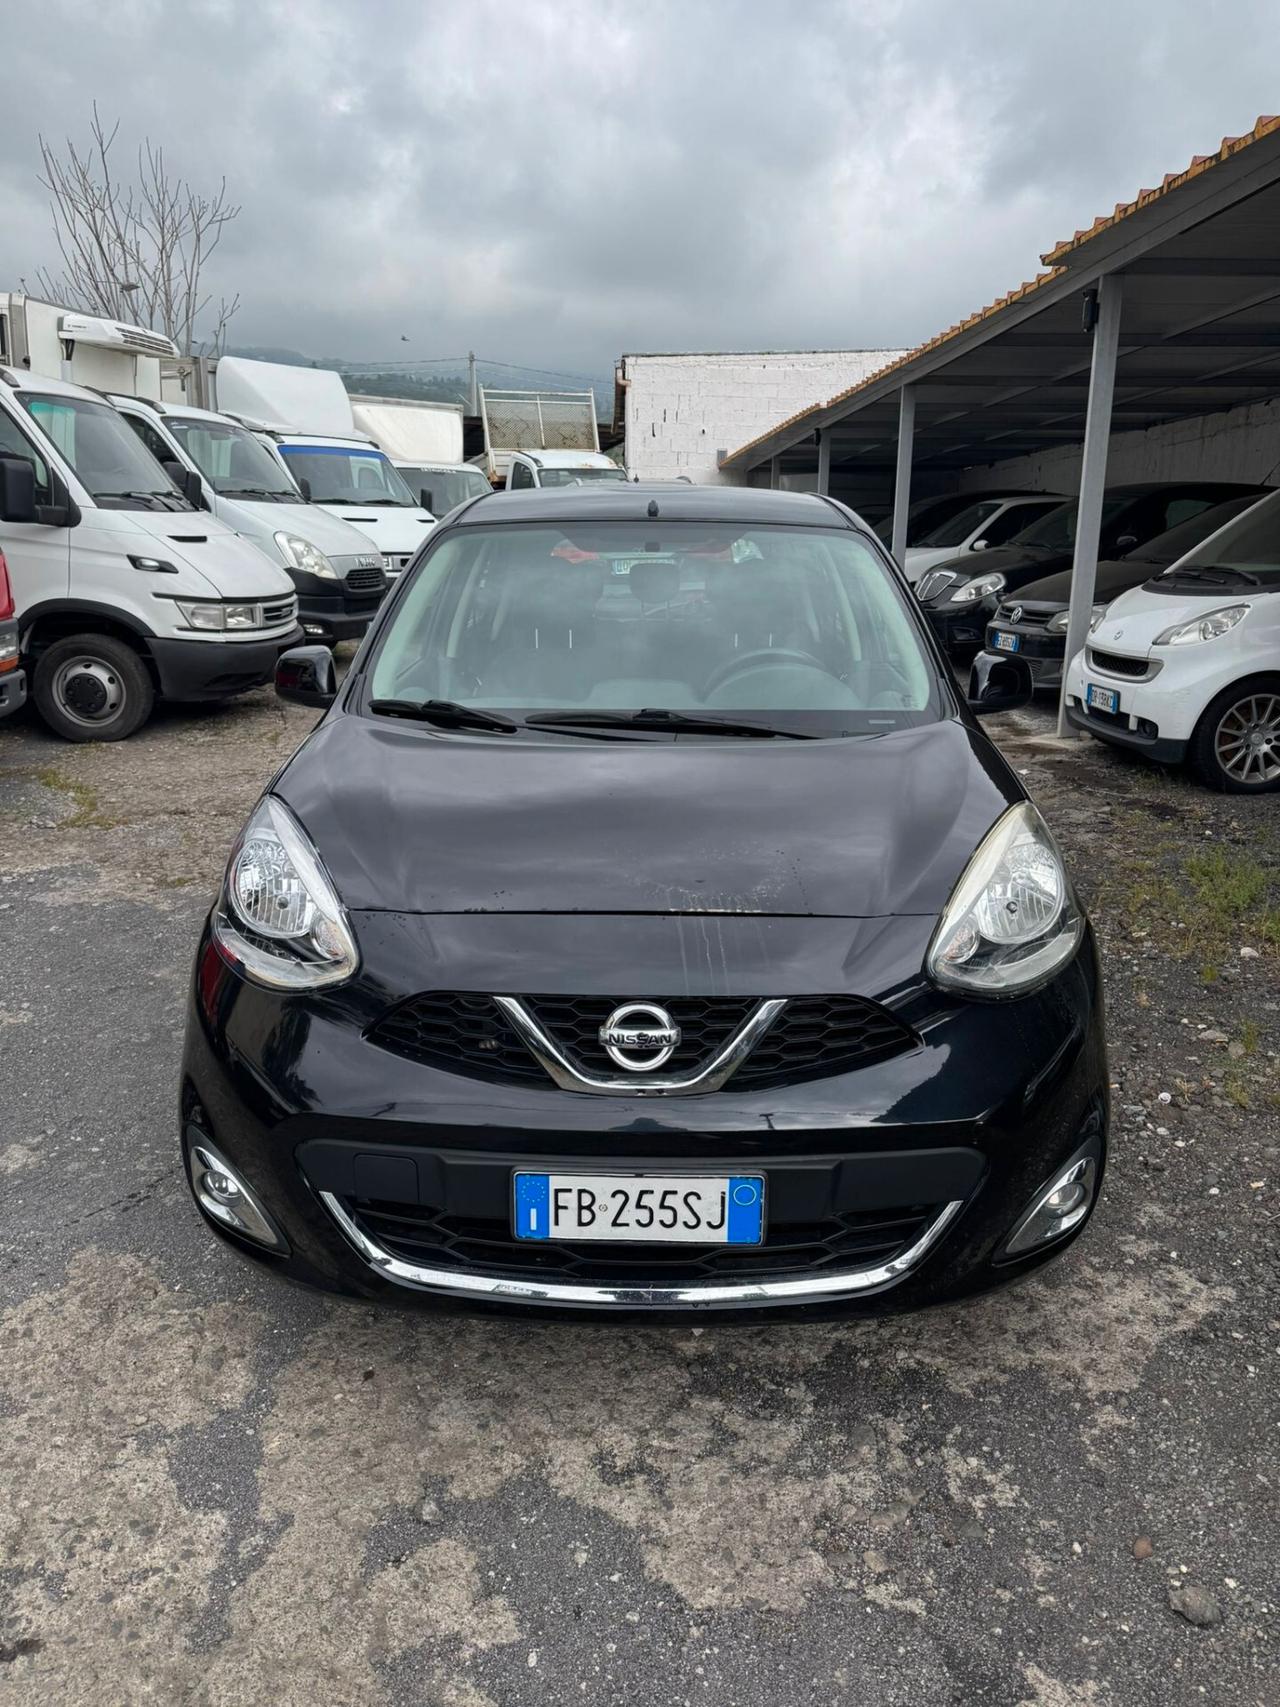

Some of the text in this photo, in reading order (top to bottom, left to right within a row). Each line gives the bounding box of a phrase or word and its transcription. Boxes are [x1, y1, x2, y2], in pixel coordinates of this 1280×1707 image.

[608, 1032, 673, 1046] NISSAN
[553, 1188, 727, 1230] FB 255SJ
